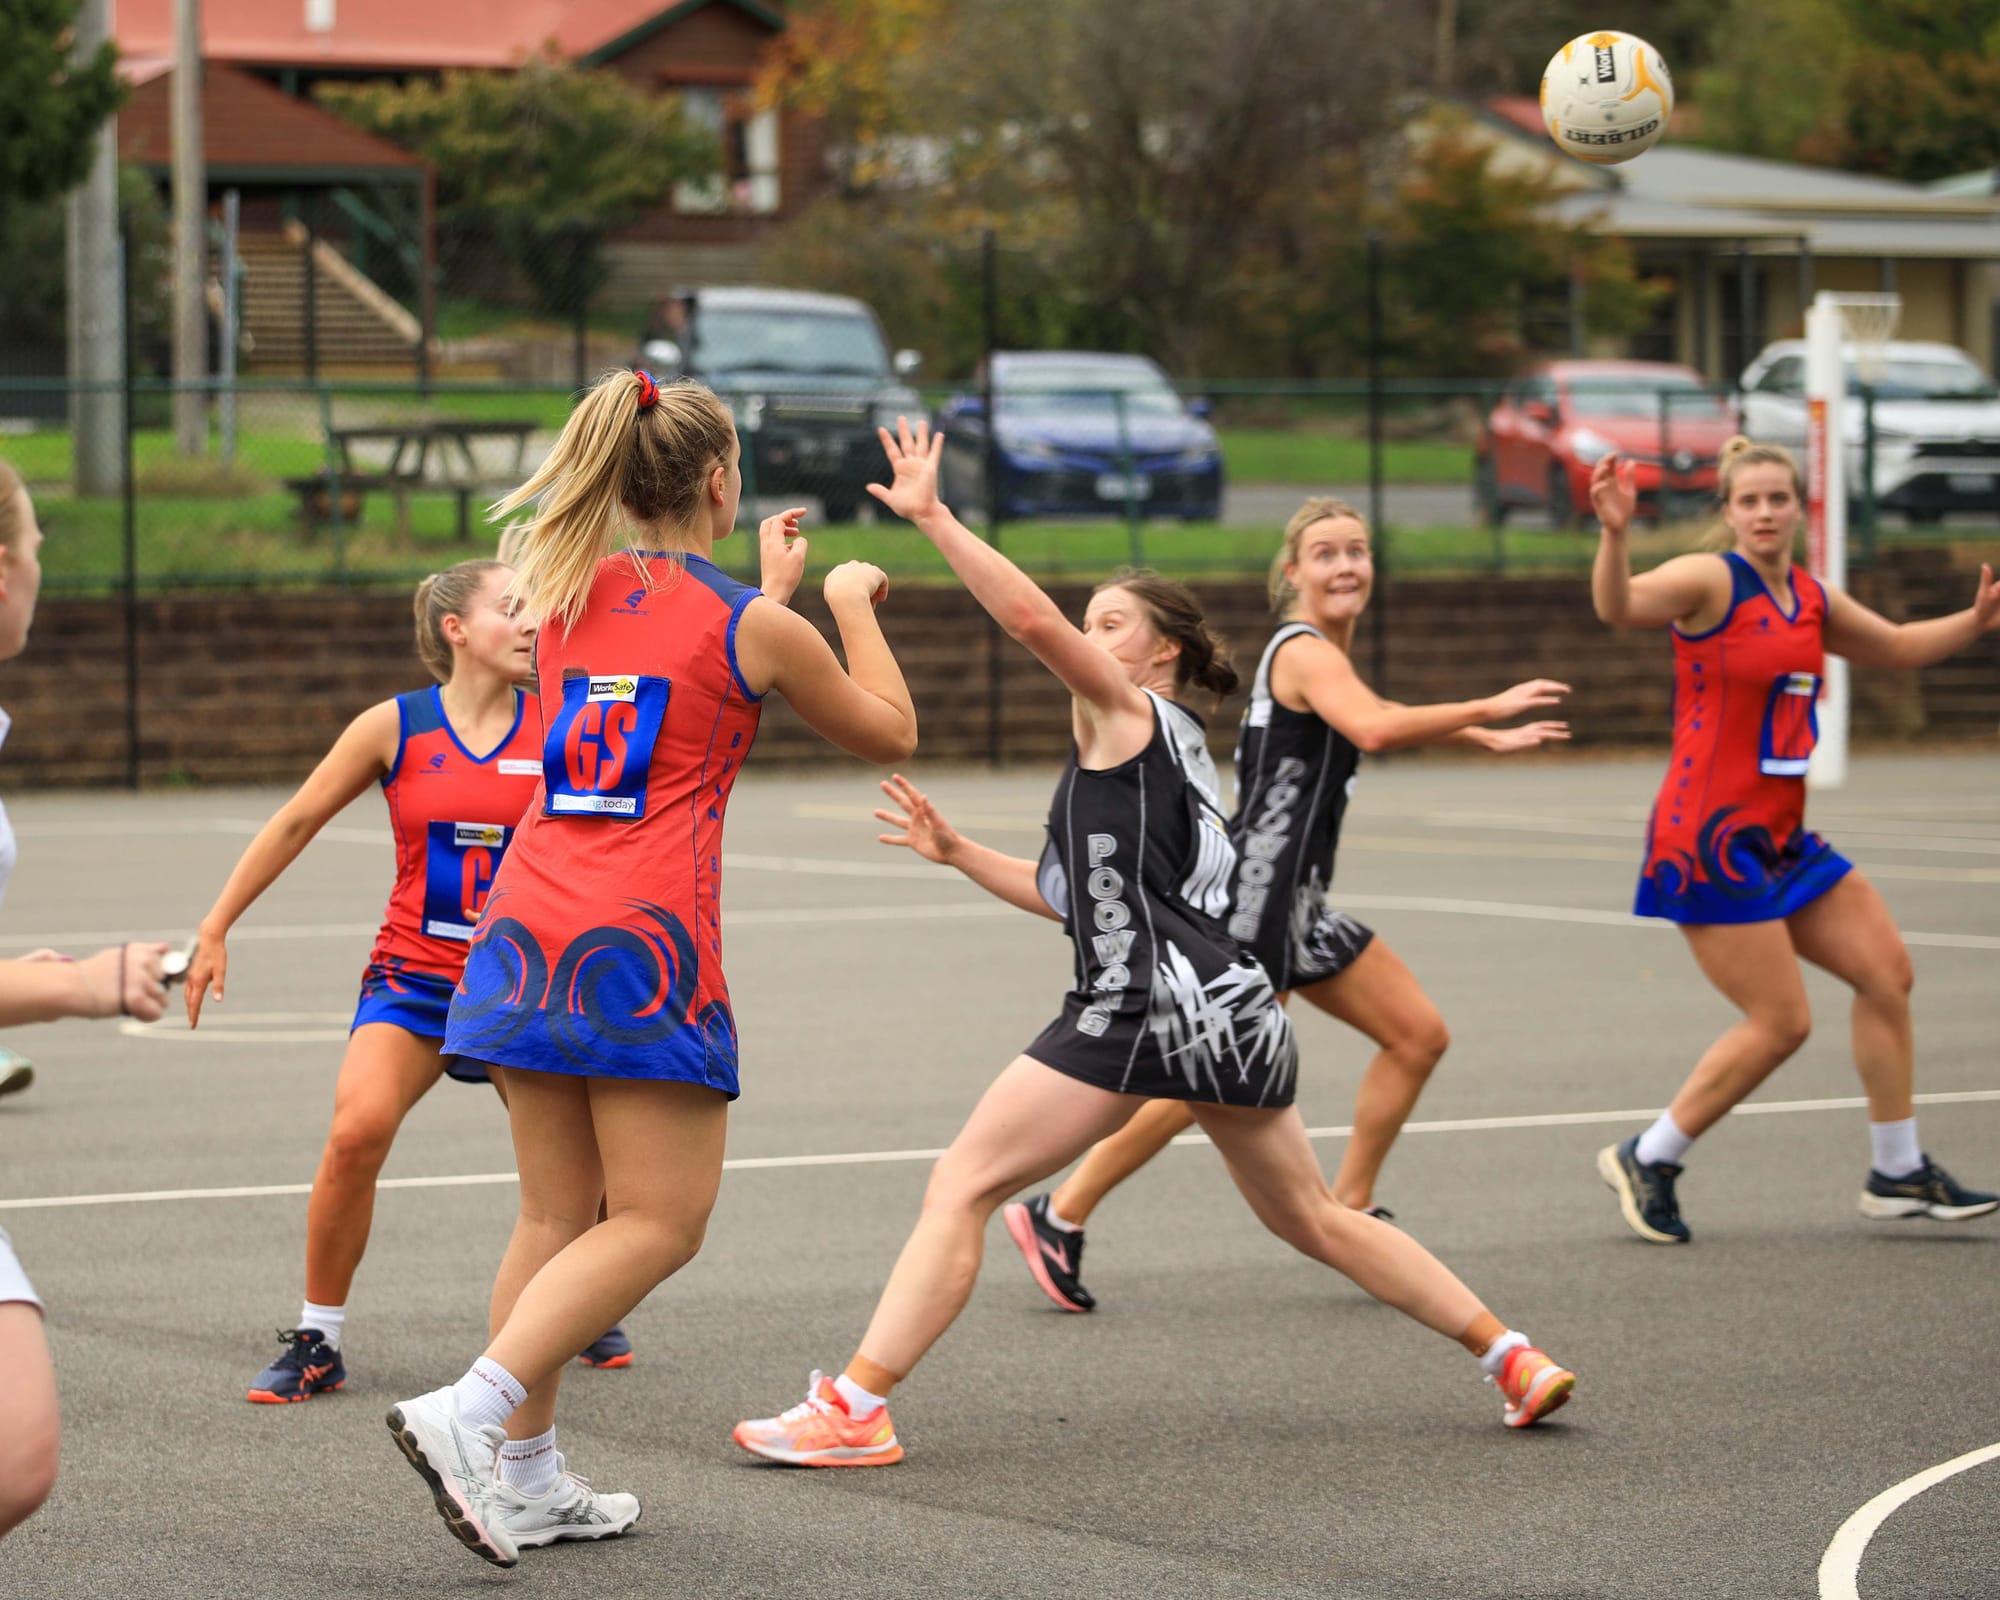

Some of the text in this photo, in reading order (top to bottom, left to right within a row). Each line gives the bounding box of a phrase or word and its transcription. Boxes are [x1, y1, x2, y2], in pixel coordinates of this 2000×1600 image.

[1566, 120, 1658, 145] GILBERT
[565, 702, 638, 791] GS
[1227, 757, 1306, 942] POOWONG
